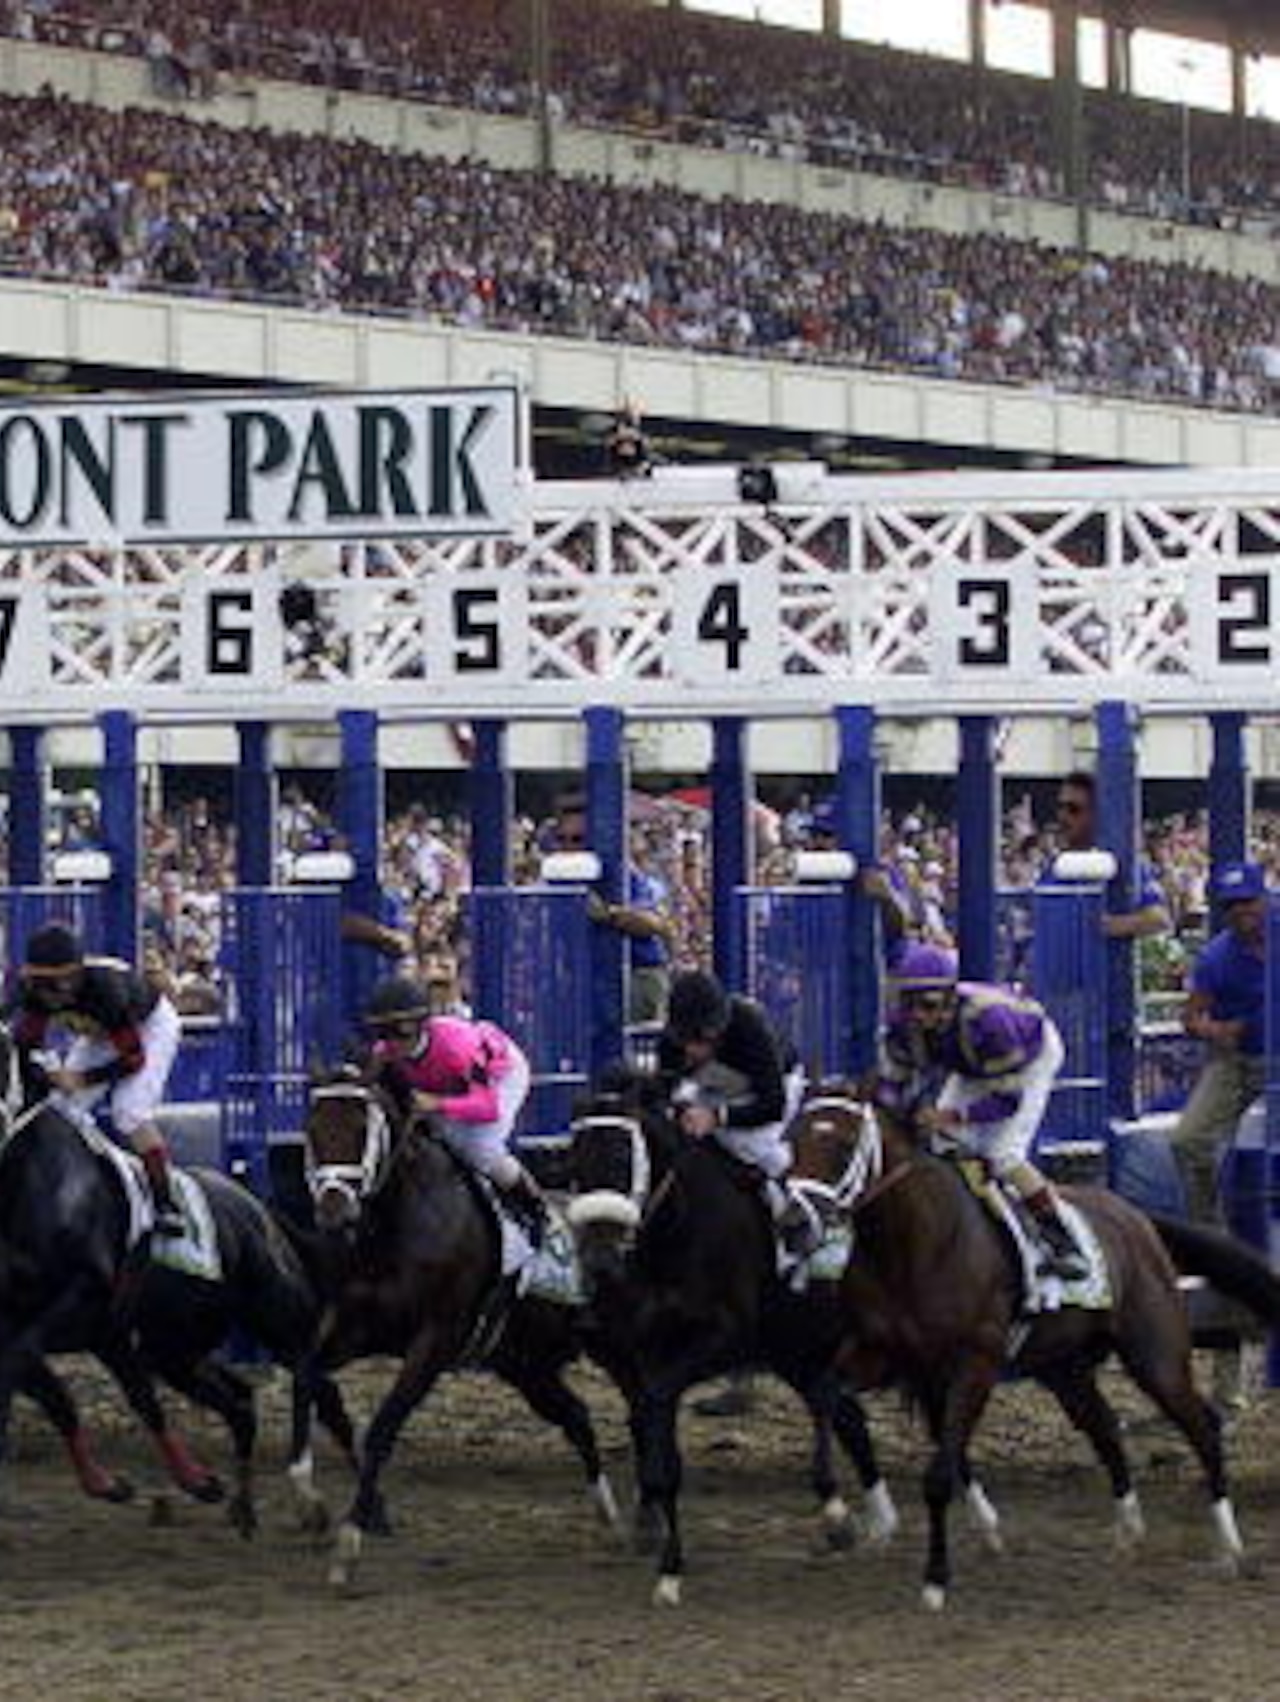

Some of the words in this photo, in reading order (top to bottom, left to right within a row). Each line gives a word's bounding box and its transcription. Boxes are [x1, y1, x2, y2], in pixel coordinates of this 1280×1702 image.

[225, 405, 496, 523] PARK
[206, 591, 254, 675] 6
[451, 588, 500, 673] 5
[696, 582, 750, 670] 4
[957, 579, 1010, 666] 3
[1217, 573, 1271, 663] 2
